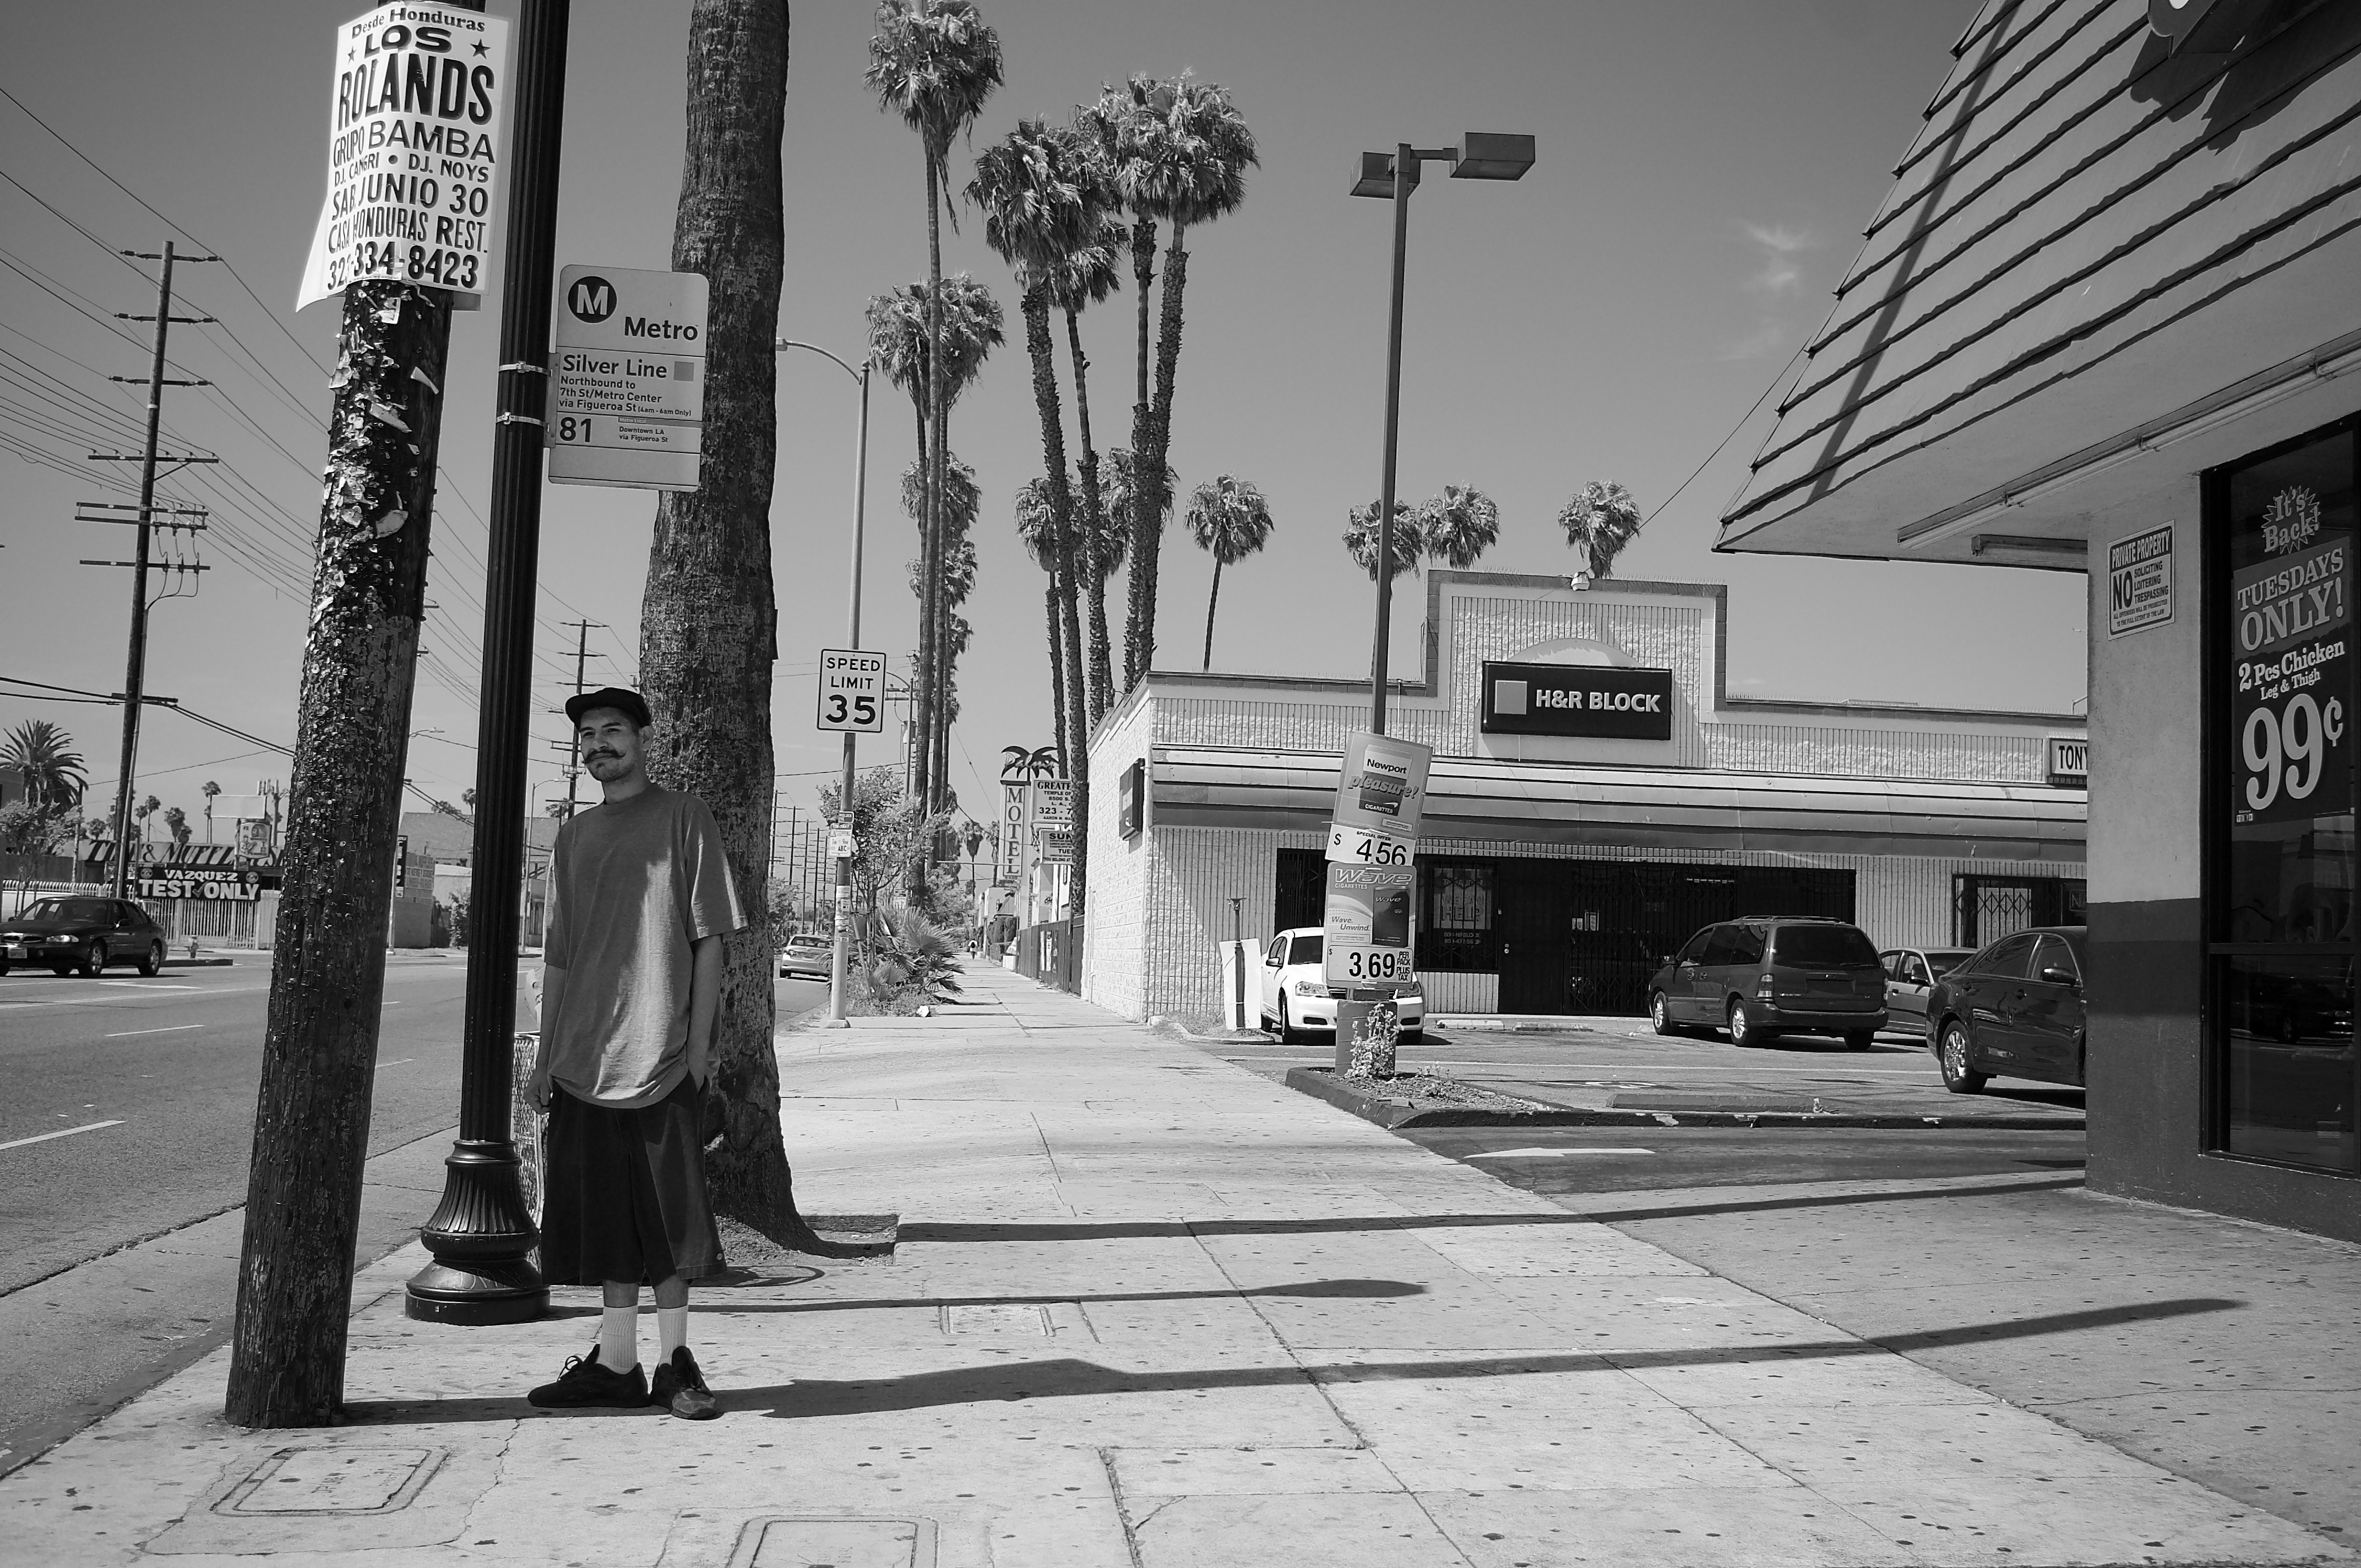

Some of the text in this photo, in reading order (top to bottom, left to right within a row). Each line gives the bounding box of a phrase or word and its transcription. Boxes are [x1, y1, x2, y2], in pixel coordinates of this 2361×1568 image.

[352, 7, 485, 39] Desde Honduras
[364, 25, 453, 59] LOS
[338, 53, 495, 132] ROLANDS
[334, 119, 495, 168] GRUPO BAMBA
[409, 153, 433, 173] DJ.
[440, 158, 489, 183] NOYS
[358, 173, 439, 209] JUNIO
[449, 183, 488, 217] 30
[329, 206, 488, 254] CASA HONDURAS REST.
[577, 284, 608, 315] M
[624, 316, 698, 341] Metro
[563, 354, 668, 379] Silver Line
[561, 375, 636, 390] Northbound to
[559, 399, 574, 408] via
[577, 400, 623, 412] Figueroa
[626, 404, 637, 412] St
[560, 388, 662, 403] 7th St/Metro Center
[560, 417, 592, 443] 81
[2274, 489, 2306, 522] It's
[2264, 505, 2320, 553] Back!
[2112, 529, 2172, 569] PRIVATE PROPERTY
[2134, 560, 2163, 579] SOLICITING
[2237, 547, 2344, 612] TUESDAYS
[2113, 570, 2133, 612] NO
[2134, 574, 2161, 592] LOITERING
[2134, 585, 2169, 604] TRESPASSING
[2240, 577, 2344, 651] ONLY!
[826, 657, 880, 672] SPEED
[2238, 640, 2345, 692] 2 Pcs Chicken
[831, 676, 874, 690] LIMIT
[2260, 668, 2321, 701] Leg & Thigh
[825, 694, 876, 725] 35
[1536, 689, 1661, 713] H&R BLOCK
[1367, 759, 1407, 774] Newport
[1348, 774, 1419, 799] pleasure!
[1365, 803, 1393, 813] CIGARETTES
[1007, 787, 1024, 874] MOTEL
[1356, 830, 1377, 839] SPECIAL
[1334, 833, 1407, 866] $ 4.56
[164, 869, 238, 882] VAZQUEZ
[1335, 868, 1413, 885] Wave
[139, 879, 260, 900] TEST ONLY
[1349, 951, 1395, 979] 3.69
[1399, 951, 1410, 959] PER
[1396, 966, 1411, 974] PLUS
[1397, 958, 1411, 966] PACK
[1397, 973, 1408, 982] TAX
